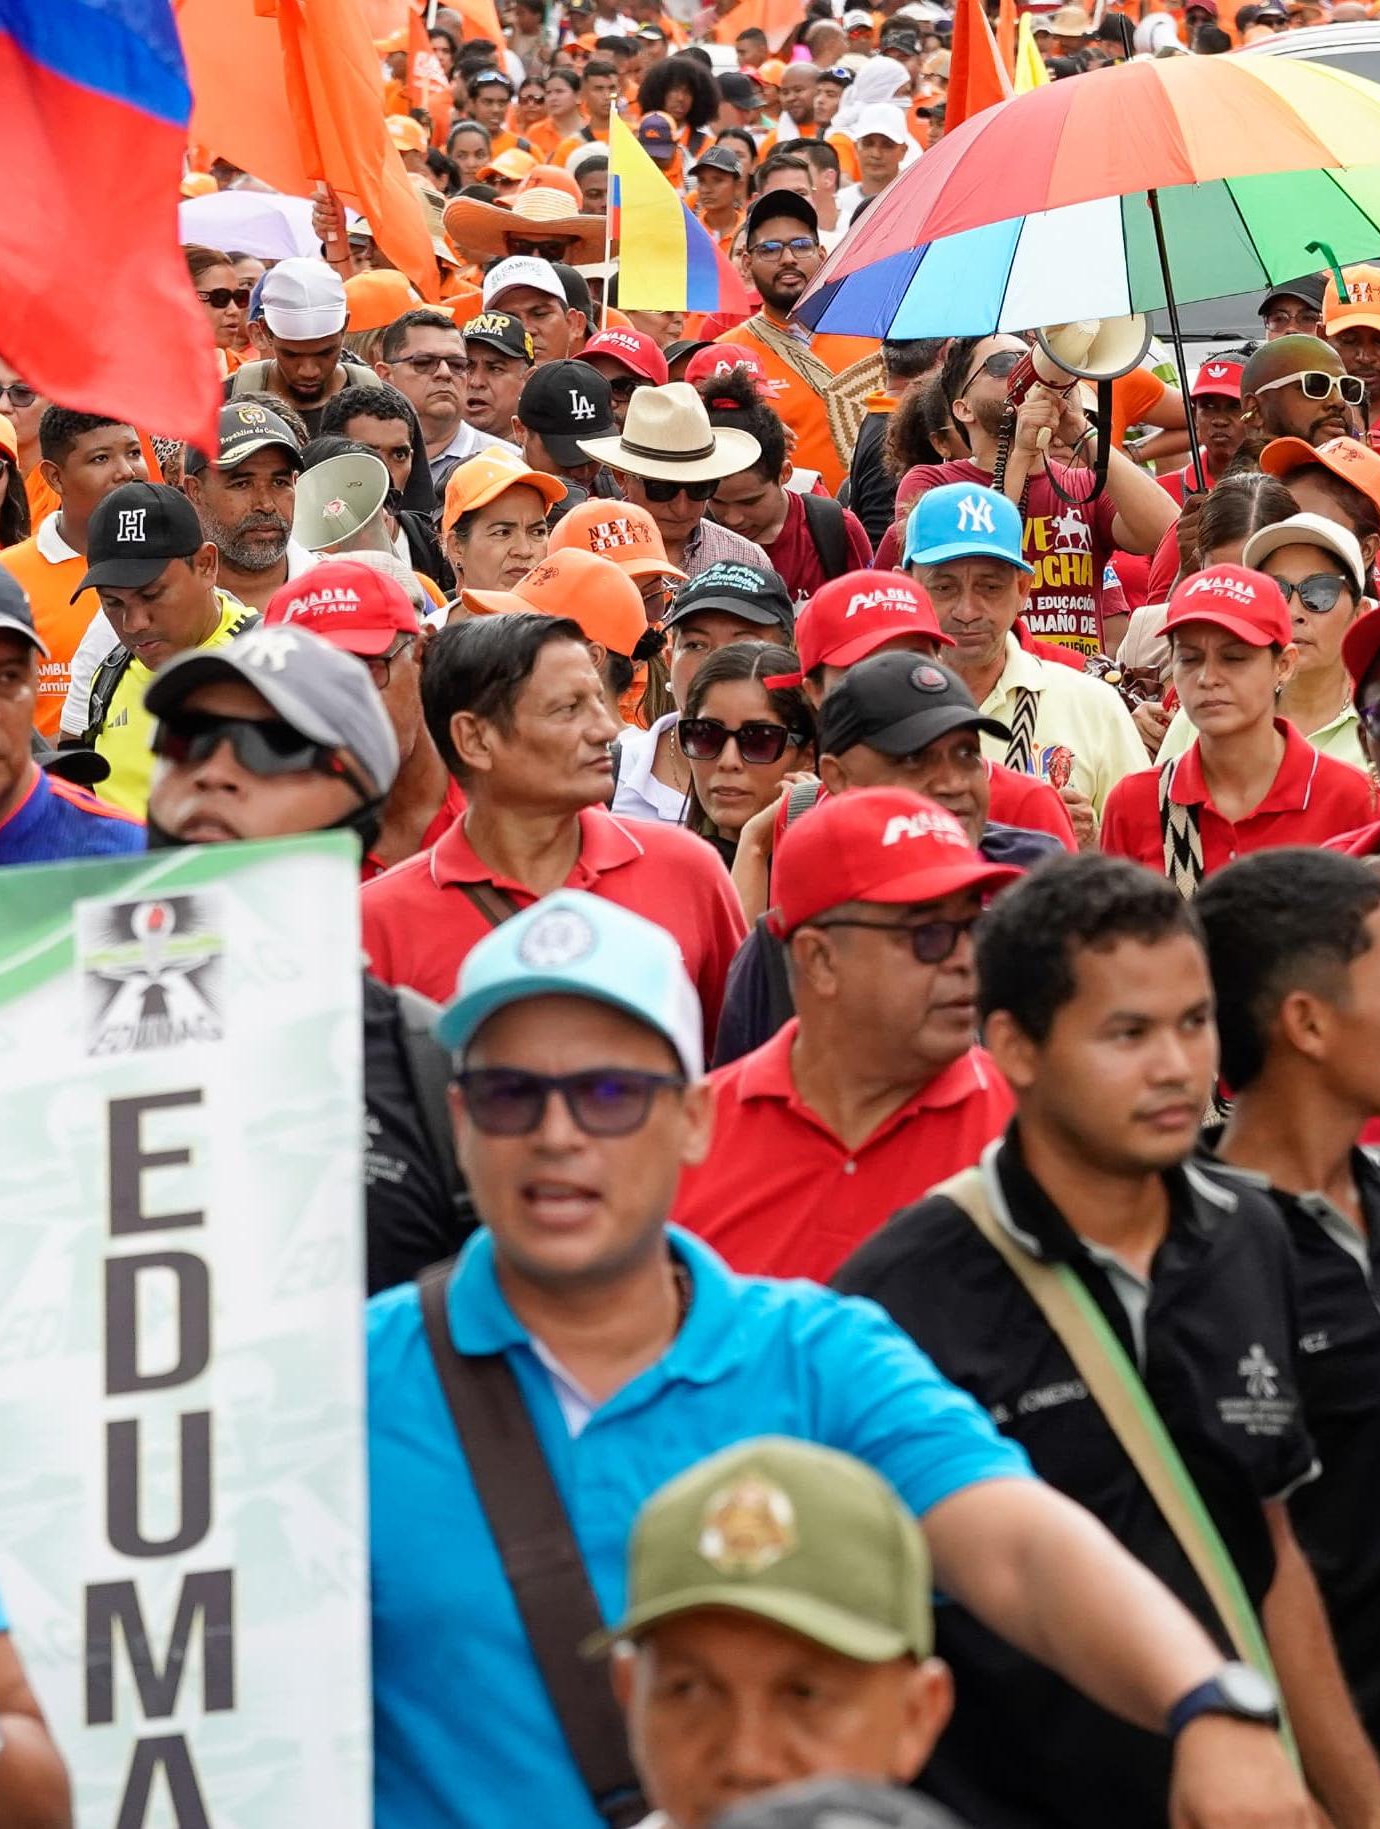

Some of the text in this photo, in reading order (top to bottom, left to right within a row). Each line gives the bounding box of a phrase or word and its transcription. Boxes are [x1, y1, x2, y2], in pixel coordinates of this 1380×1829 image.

[570, 389, 595, 420] LA
[118, 508, 146, 542] H
[957, 496, 996, 533] NY
[588, 518, 634, 540] NUEVA
[591, 534, 640, 552] ESCUELA
[1037, 594, 1096, 613] EDUCACIÓN
[1080, 616, 1098, 635] DE
